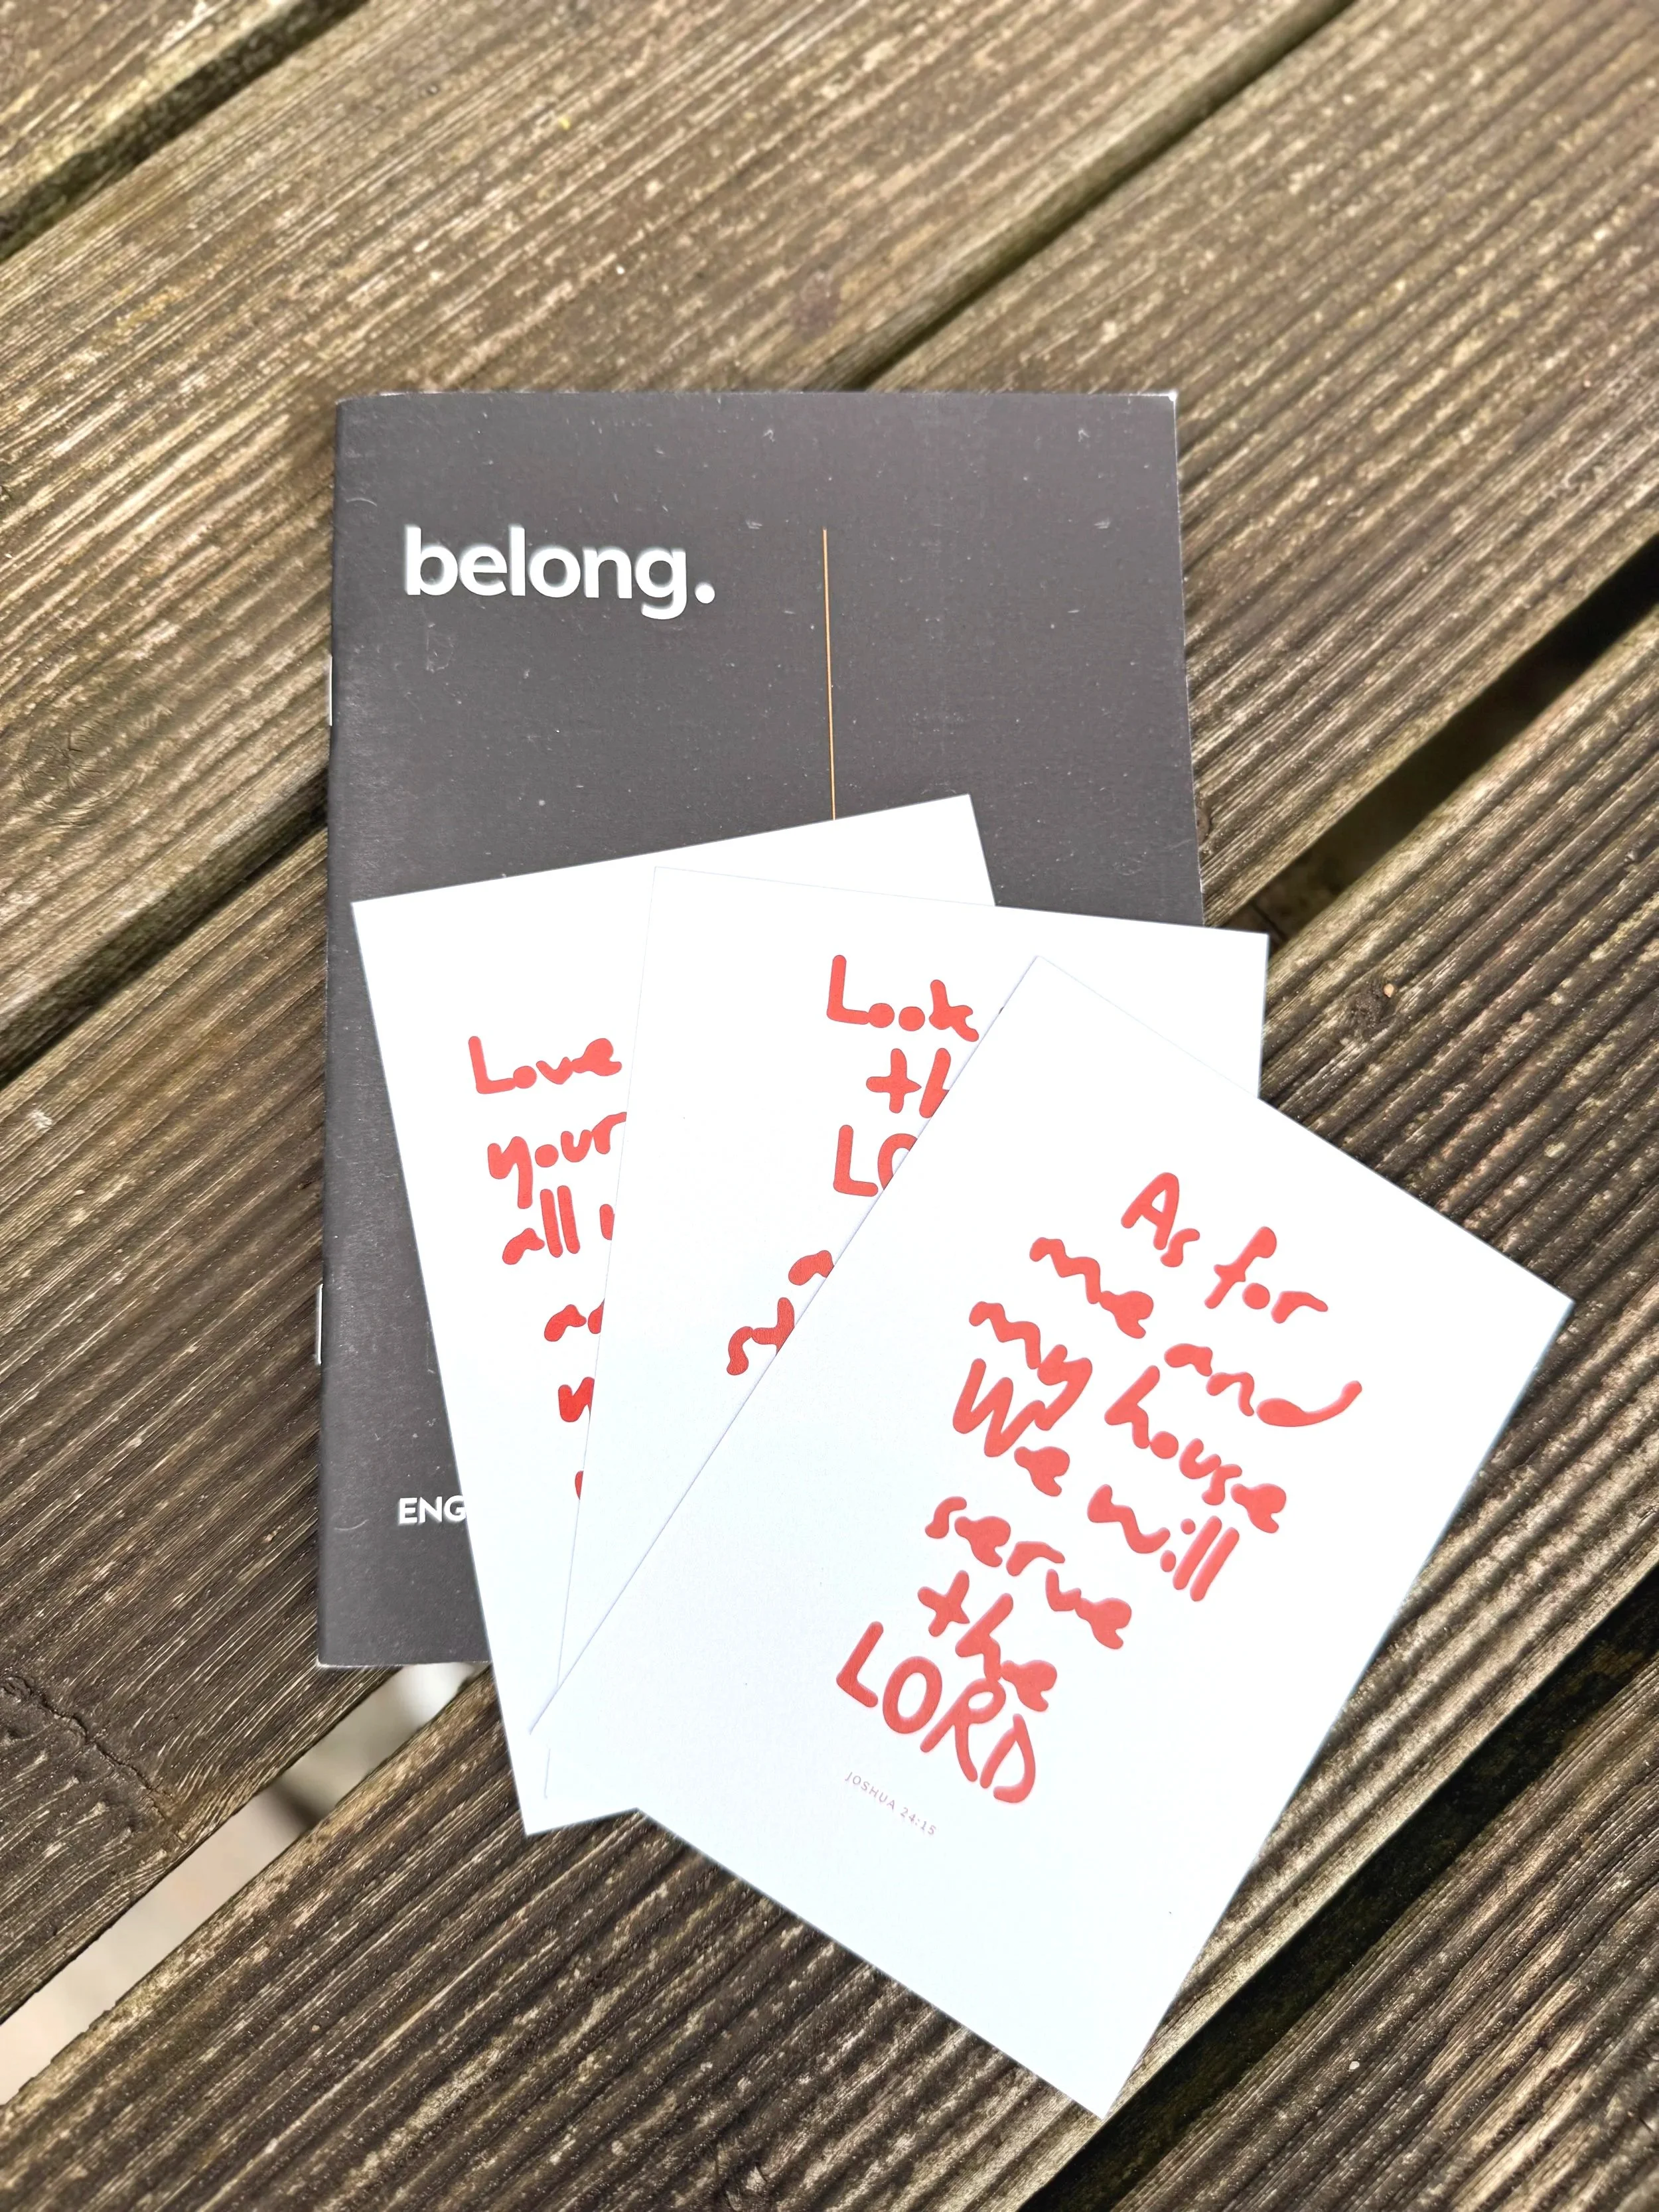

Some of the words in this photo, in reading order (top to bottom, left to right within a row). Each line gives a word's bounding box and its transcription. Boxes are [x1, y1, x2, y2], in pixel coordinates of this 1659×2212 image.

[405, 524, 715, 620] belong.
[826, 954, 980, 1043] Look
[469, 1036, 622, 1094] Love
[487, 1112, 628, 1209] your
[502, 1185, 581, 1265] all
[1121, 1172, 1200, 1268] As
[1205, 1226, 1328, 1324] for
[1029, 1237, 1154, 1339] me
[1165, 1344, 1362, 1428] and
[969, 1301, 1093, 1431] my
[1104, 1366, 1287, 1534] house
[398, 1495, 467, 1525] ENG
[1087, 1485, 1240, 1602] will
[926, 1497, 1132, 1650] serve
[918, 1572, 1057, 1712] the
[836, 1622, 1036, 1804] LORD
[845, 1771, 895, 1811] JOSHUA
[900, 1806, 936, 1835] 24:15
